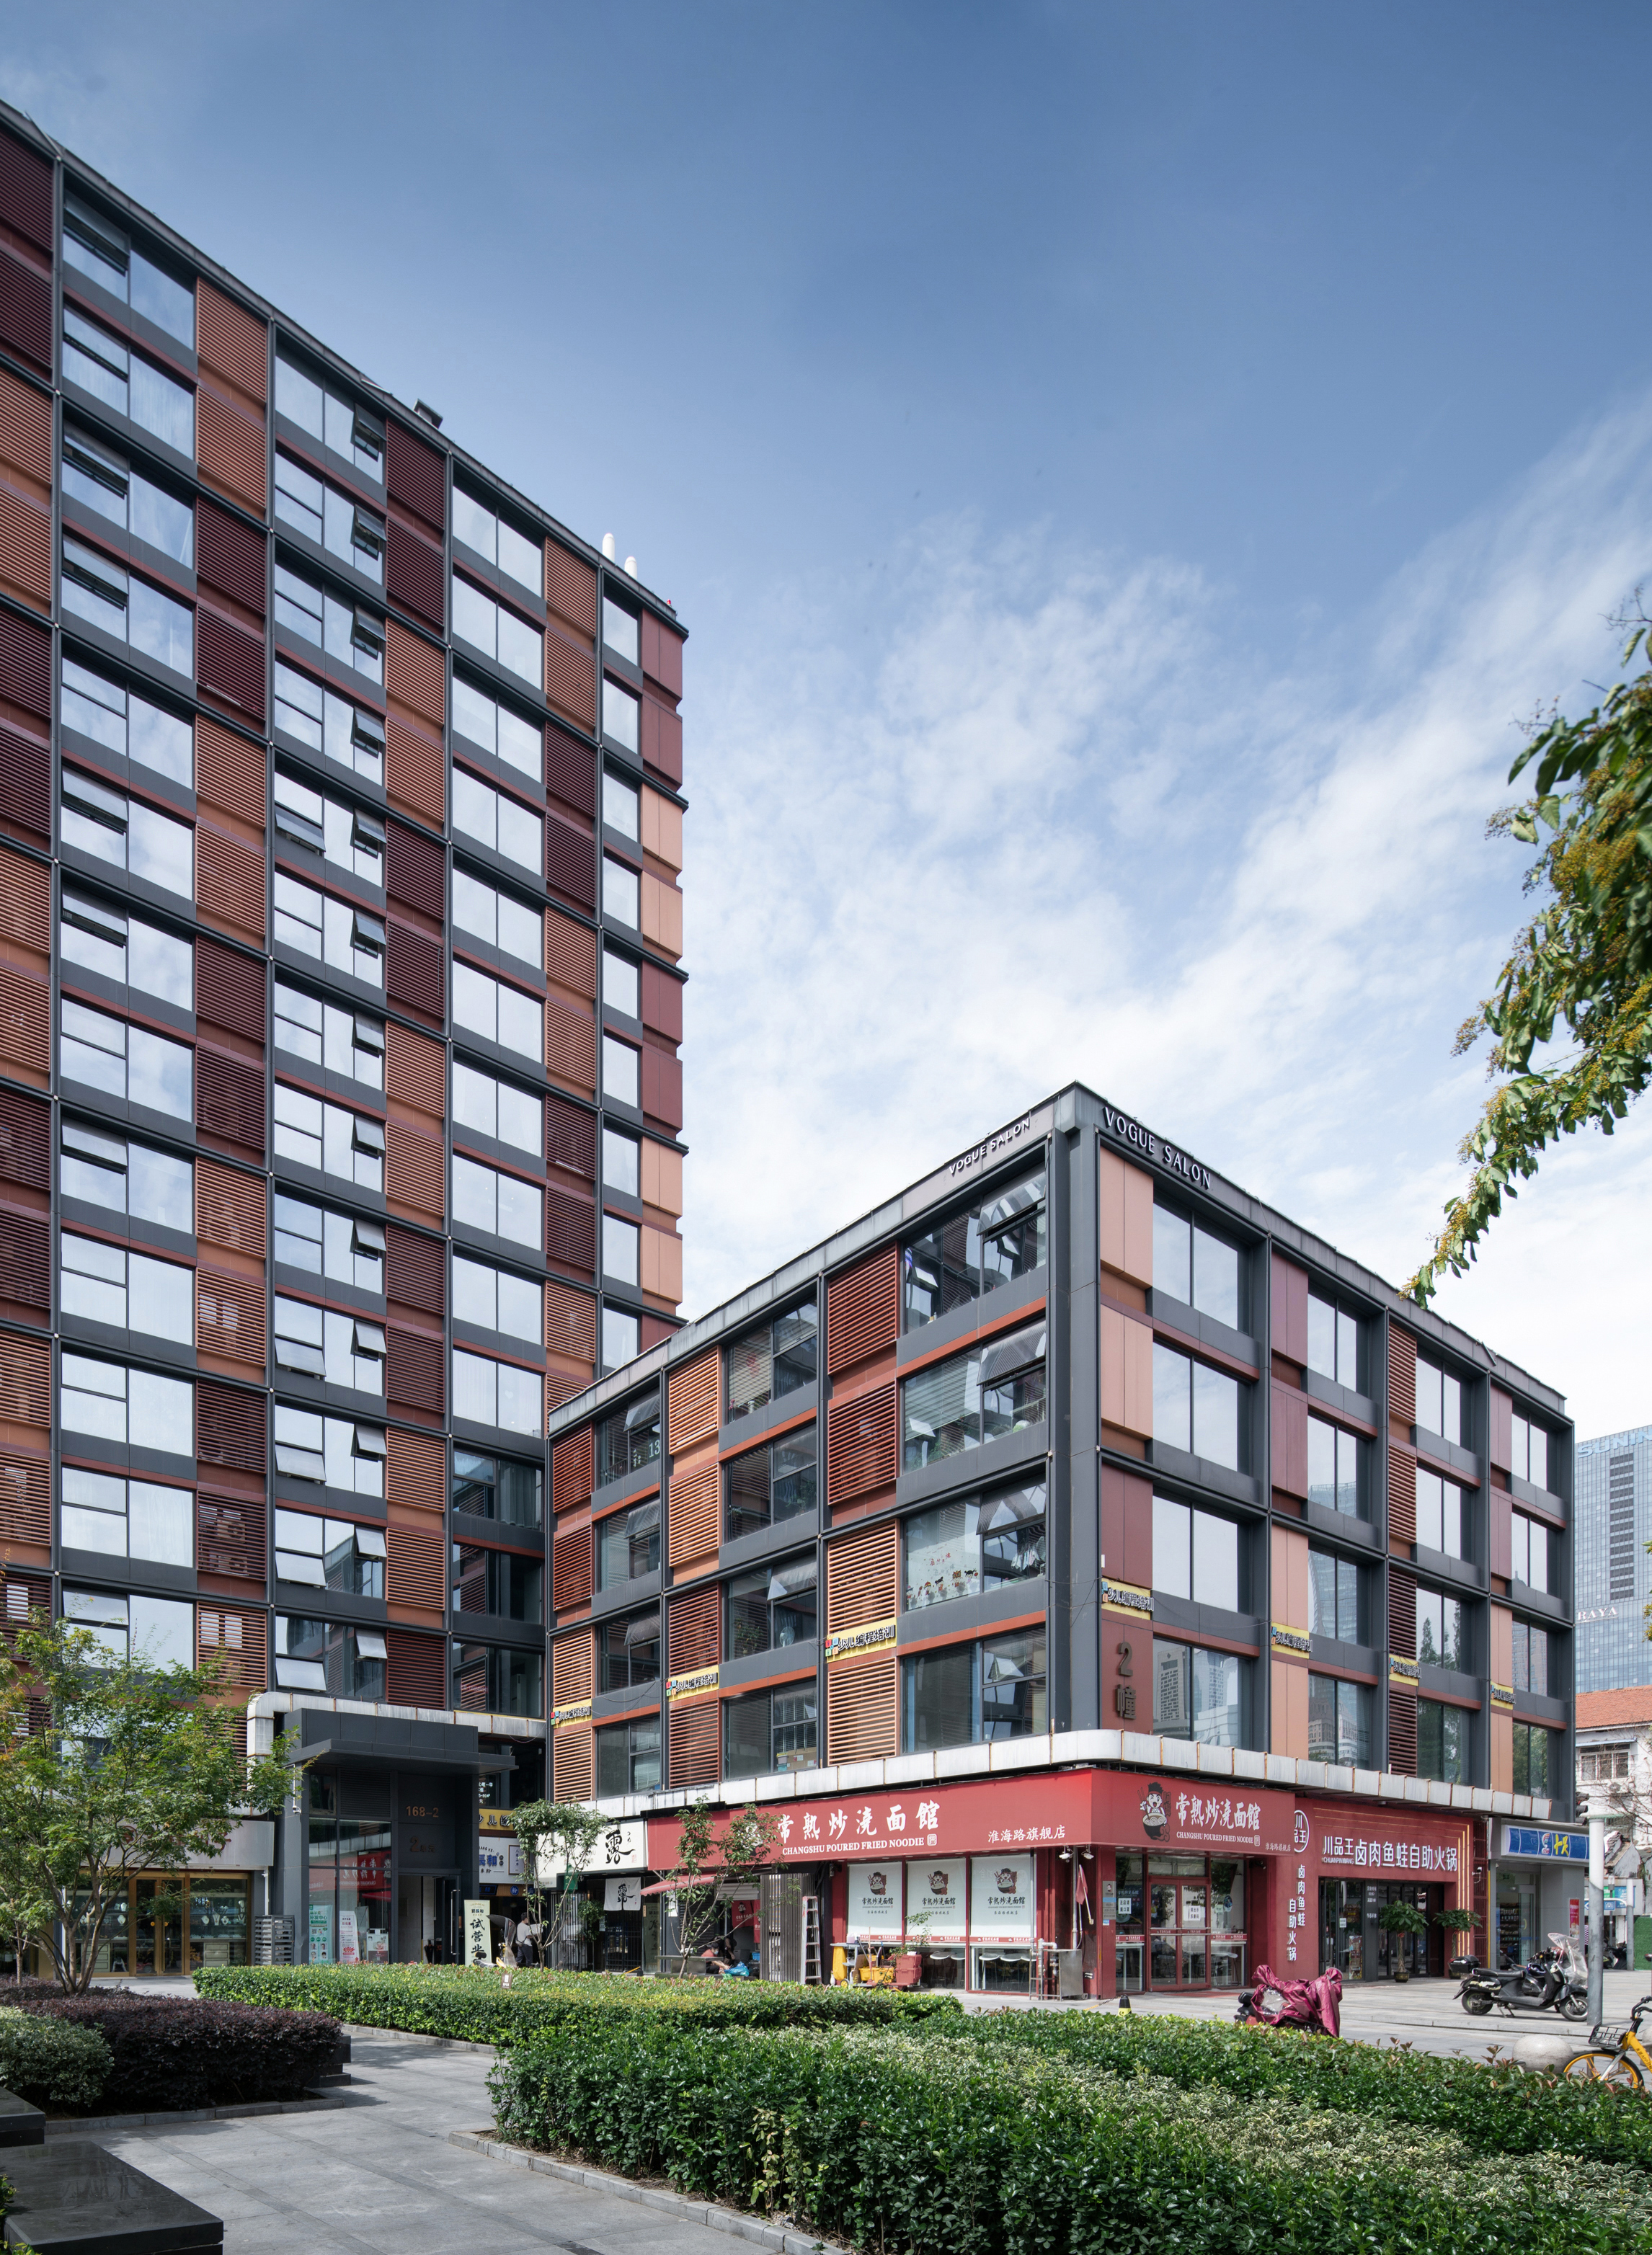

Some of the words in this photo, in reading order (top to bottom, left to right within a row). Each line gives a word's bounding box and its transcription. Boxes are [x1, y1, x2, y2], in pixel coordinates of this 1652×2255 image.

[948, 1146, 987, 1175] VOGUE
[990, 1117, 1031, 1150] SALON
[1103, 1106, 1155, 1155] VOGUE
[1163, 1145, 1212, 1190] SALON
[1108, 1587, 1154, 1612] 少儿编程培训
[838, 1624, 895, 1651] 少儿编程培训
[1275, 1632, 1313, 1653] 少儿编程培训
[676, 1672, 718, 1692] 少儿编程培训
[559, 1706, 592, 1721] 少儿编程培训
[406, 1805, 439, 1818] 168-2
[988, 1825, 1066, 1844] 淮海路旗舰店
[1176, 1831, 1203, 1840] CHANGSHU
[782, 1845, 825, 1856] CHANGSHU
[826, 1843, 860, 1853] POURED
[861, 1841, 887, 1850] FRIED
[1265, 1842, 1291, 1852] 淮海路旗舰店
[1323, 1836, 1354, 1856] 川品王
[1355, 1838, 1457, 1872] 卤肉鱼蛙自助火锅
[470, 1918, 485, 1954] 试营业
[1287, 1898, 1297, 1961] 自助火锅
